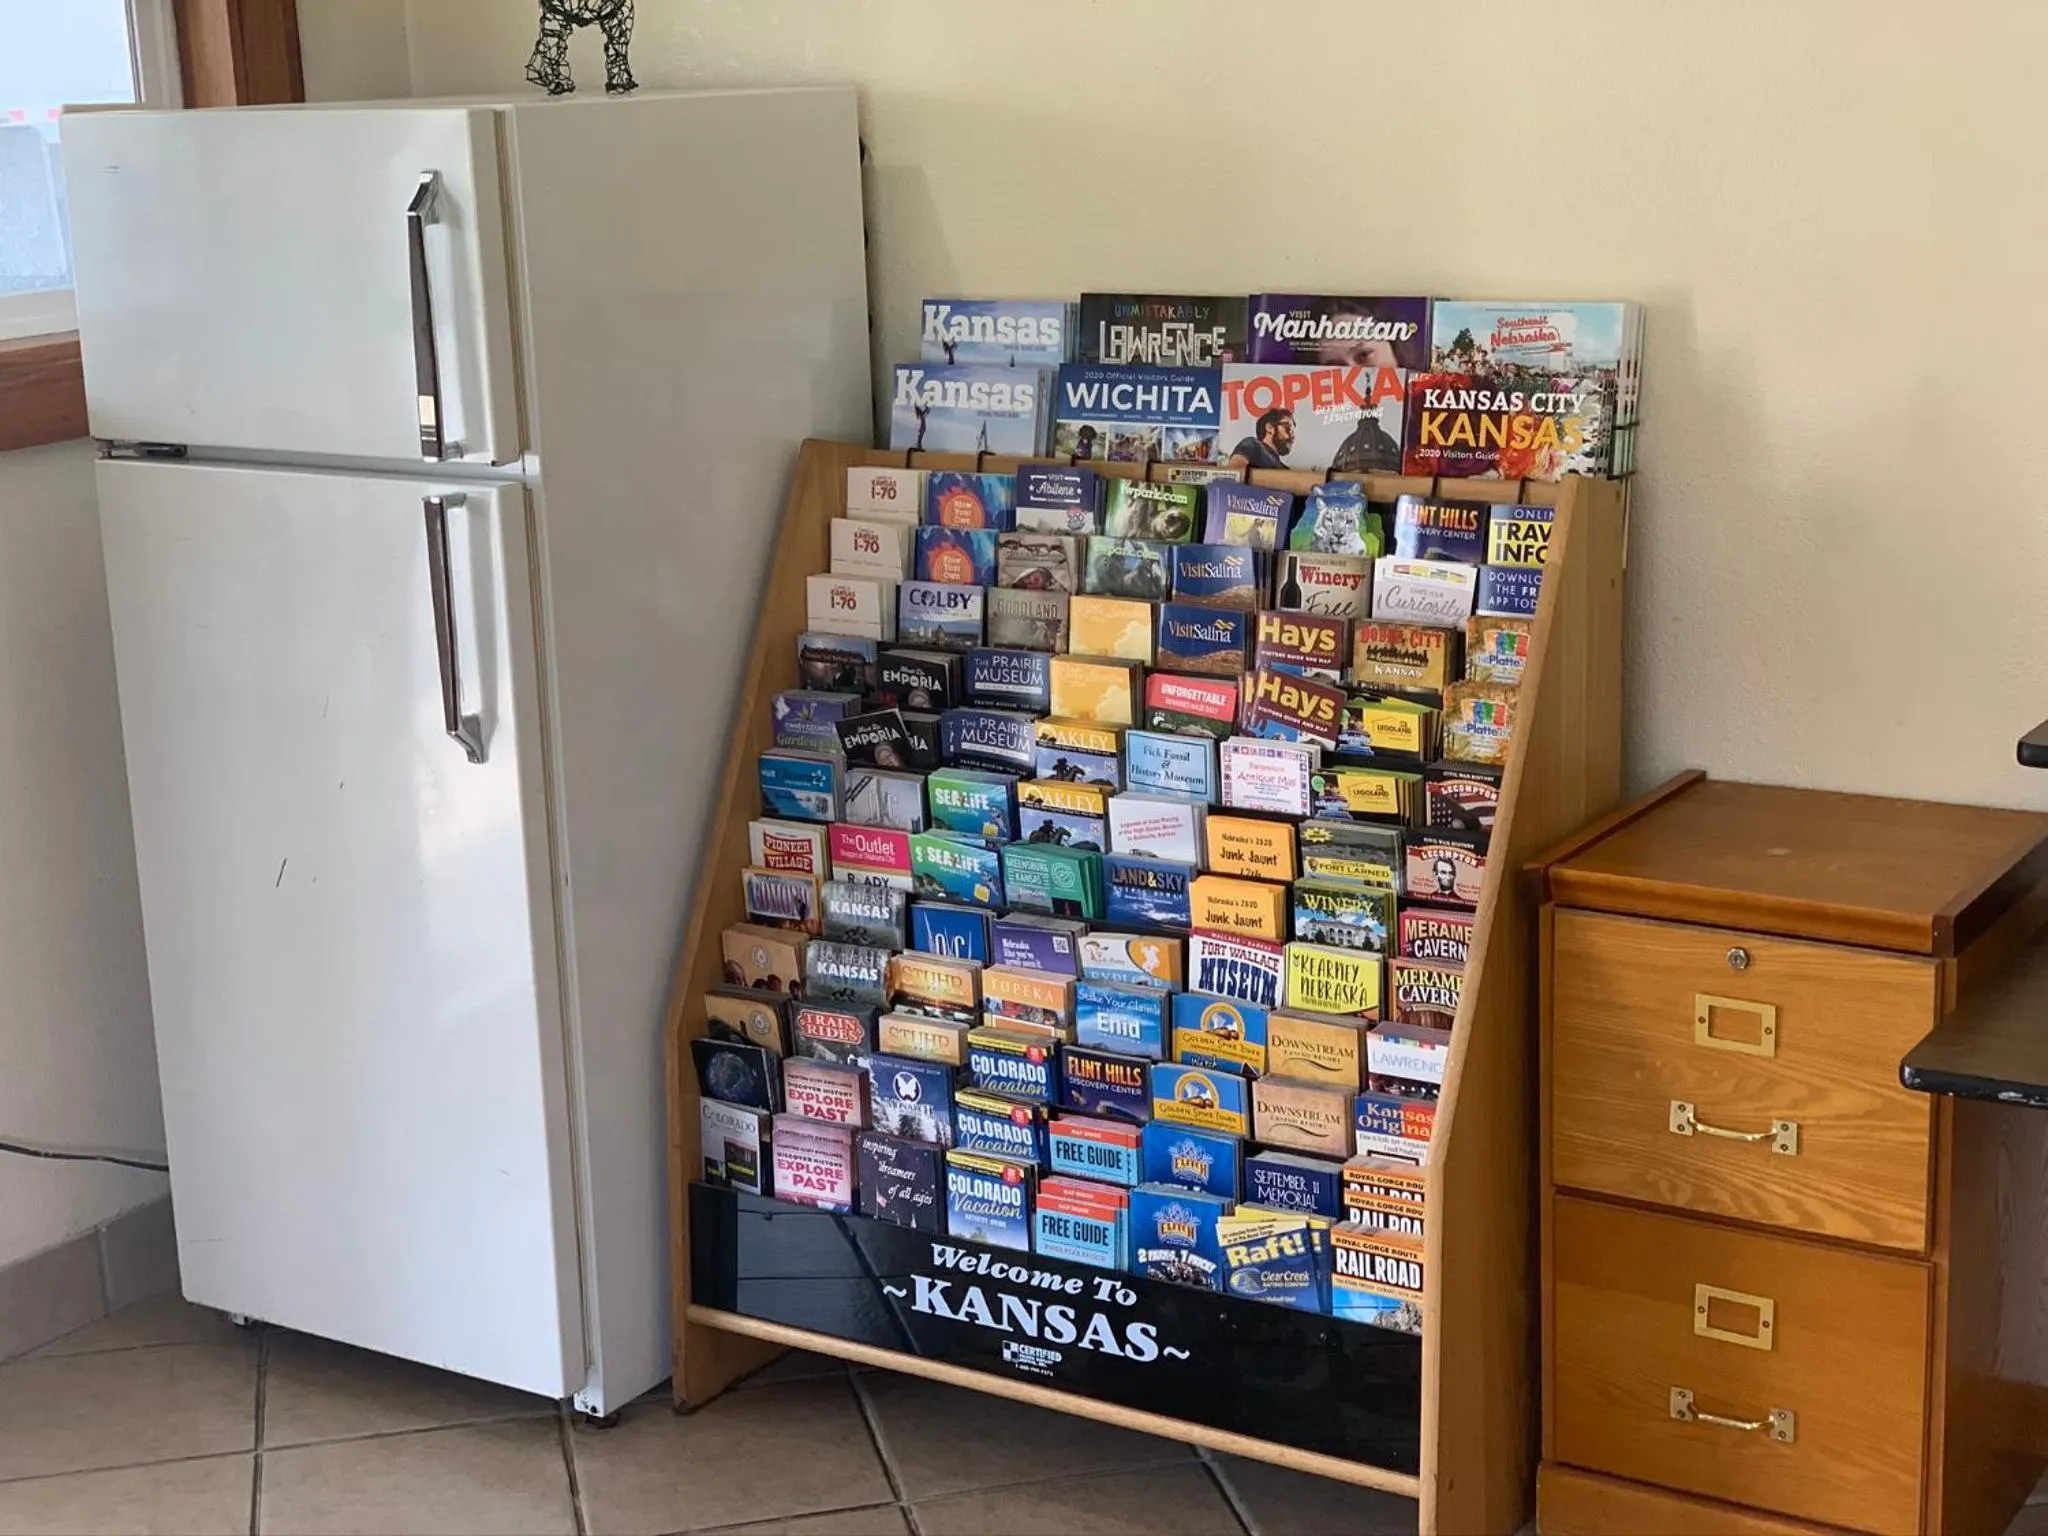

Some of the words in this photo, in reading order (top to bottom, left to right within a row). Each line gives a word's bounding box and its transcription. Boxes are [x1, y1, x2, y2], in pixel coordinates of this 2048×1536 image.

[924, 304, 1060, 345] Kansas
[1289, 310, 1311, 320] VISIT
[1254, 312, 1411, 343] Manhattan
[1490, 328, 1558, 346] Nebraska
[1100, 321, 1226, 366] LAWRENCE
[1106, 372, 1136, 381] Official
[1172, 374, 1195, 382] Guide
[895, 369, 1034, 411] Kansas
[1066, 382, 1214, 414] WICHITA
[1221, 367, 1404, 421] TOPEKA
[1424, 389, 1523, 411] KANSAS
[1531, 393, 1585, 413] CITY
[1420, 411, 1584, 450] KANSAS
[1419, 448, 1441, 458] 2020
[1442, 451, 1472, 459] Visitors
[1474, 451, 1500, 461] Guide
[872, 486, 896, 500] I-70
[1036, 483, 1074, 496] Abilene
[1439, 508, 1479, 531] HILLS
[1442, 530, 1476, 540] CENTER
[854, 540, 880, 553] I-70
[1181, 560, 1242, 579] VisitSalina
[1300, 565, 1365, 590] Winery
[910, 588, 972, 610] COLBY
[1496, 585, 1517, 594] THE
[830, 596, 856, 610] I-70
[1385, 585, 1466, 620] Curiosity
[1488, 596, 1510, 606] APP
[1169, 621, 1231, 643] VisitSalina
[1259, 614, 1335, 653] Hays
[1413, 631, 1442, 649] CITY
[974, 658, 989, 666] THE
[992, 655, 1043, 670] PRAIRIE
[1374, 665, 1423, 678] KANSAS
[883, 670, 942, 691] EMPORIA
[974, 668, 1043, 685] MUSEUM
[1257, 670, 1336, 720] Hays
[980, 718, 1030, 736] PRAIRIE
[1376, 724, 1412, 735] LEGOLAND
[843, 727, 902, 750] EMPORIA
[961, 730, 1031, 752] MUSEUM
[1039, 727, 1109, 751] OAKLEY
[1164, 771, 1205, 786] Museum
[1024, 785, 1097, 810] OAKLEY
[1352, 788, 1389, 798] LEGOLAND
[1441, 786, 1497, 801] LECOMPTON
[766, 836, 810, 853] PIONEER
[841, 834, 855, 844] The
[855, 835, 895, 855] Outlet
[768, 855, 811, 870] VILLAGE
[1219, 848, 1244, 861] Junk
[1249, 851, 1278, 867] Jaunt
[1421, 850, 1478, 867] LECOMPTON
[1111, 867, 1183, 891] LAND&SKY
[1319, 862, 1343, 873] FORT
[1346, 865, 1389, 878] LARNED
[830, 901, 890, 919] KANSAS
[1304, 893, 1374, 913] WINERY
[1205, 910, 1229, 924] Junk
[1233, 913, 1263, 929] Jaunt
[1201, 941, 1228, 957] FORT
[1230, 947, 1280, 973] WALLACE
[1414, 938, 1468, 961] CAVERN
[817, 962, 878, 981] KANSAS
[1200, 957, 1278, 1006] MUSEUM
[1300, 956, 1361, 986] KEARNEY,
[991, 979, 1055, 1002] TOPEKA
[1105, 996, 1126, 1007] Your
[1300, 978, 1367, 1007] NEBRASKA
[806, 1013, 858, 1031] TRAIN
[1097, 1012, 1141, 1039] Enid
[807, 1026, 858, 1043] RIDES
[1272, 1035, 1354, 1059] DOWNSTREAM
[971, 1054, 1047, 1084] COLORADO
[1068, 1056, 1104, 1078] FLINT
[1105, 1063, 1142, 1086] HILLS
[972, 1072, 1049, 1097] Vacation
[1069, 1077, 1111, 1089] DISCOVERY
[1111, 1085, 1142, 1096] CENTER
[788, 1089, 854, 1110] EXPLORE
[803, 1104, 849, 1123] PAST
[1257, 1100, 1340, 1126] DOWNSTREAM
[958, 1113, 1032, 1145] COLORADO
[862, 1139, 898, 1160] inspiring
[960, 1133, 1035, 1157] Vacation
[1056, 1140, 1085, 1162] FREE
[1087, 1146, 1123, 1169] GUIDE
[778, 1159, 844, 1180] EXPLORE
[1254, 1169, 1306, 1192] SEPTEMBER
[792, 1174, 838, 1193] PAST
[948, 1172, 1020, 1206] COLORADO
[888, 1185, 898, 1201] of
[899, 1187, 911, 1199] all
[912, 1191, 932, 1207] ages
[949, 1191, 1022, 1220] Vacation
[1258, 1186, 1318, 1209] MEMORIAL
[1350, 1198, 1374, 1206] ROYAL
[1377, 1202, 1402, 1212] GORGE
[1042, 1215, 1070, 1237] FREE
[1073, 1222, 1109, 1246] GUIDE
[1226, 1232, 1305, 1268] Raft!
[1335, 1237, 1360, 1248] ROYAL
[1363, 1242, 1389, 1253] GORGE
[1391, 1248, 1418, 1260] ROUTE
[930, 1244, 1084, 1295] Welcome
[1093, 1277, 1137, 1306] To
[1336, 1248, 1421, 1289] RAILROAD
[1019, 1345, 1062, 1363] CERTIFIED
